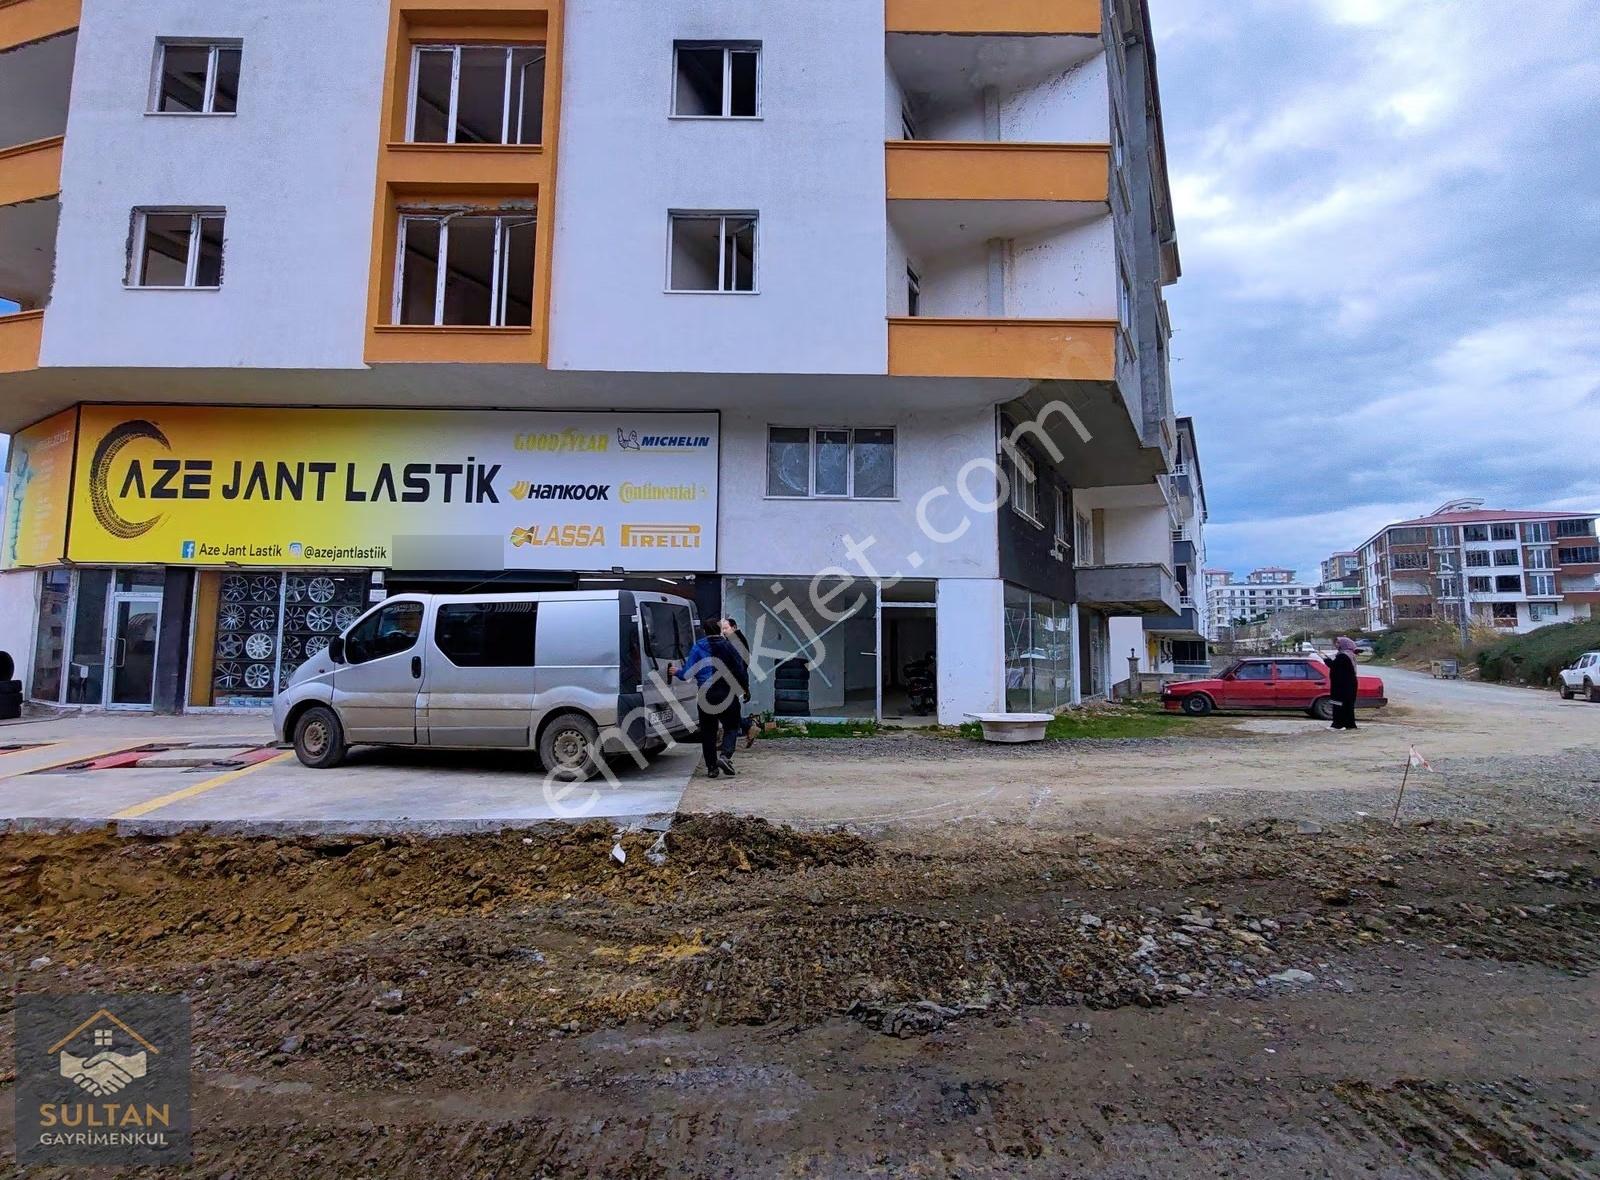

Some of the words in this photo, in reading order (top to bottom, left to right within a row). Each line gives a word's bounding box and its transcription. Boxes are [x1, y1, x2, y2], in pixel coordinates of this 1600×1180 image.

[641, 436, 710, 448] MICHELIN
[119, 459, 213, 500] AZE
[222, 460, 337, 502] JANT
[345, 456, 502, 504] LASTİK
[619, 481, 697, 503] Continental
[532, 525, 606, 548] LASSA
[620, 524, 701, 548] PIRELLI
[199, 543, 221, 556] Aze
[222, 544, 247, 557] Jant
[249, 543, 283, 558] Lastik
[303, 545, 387, 562] @azejantlastiik
